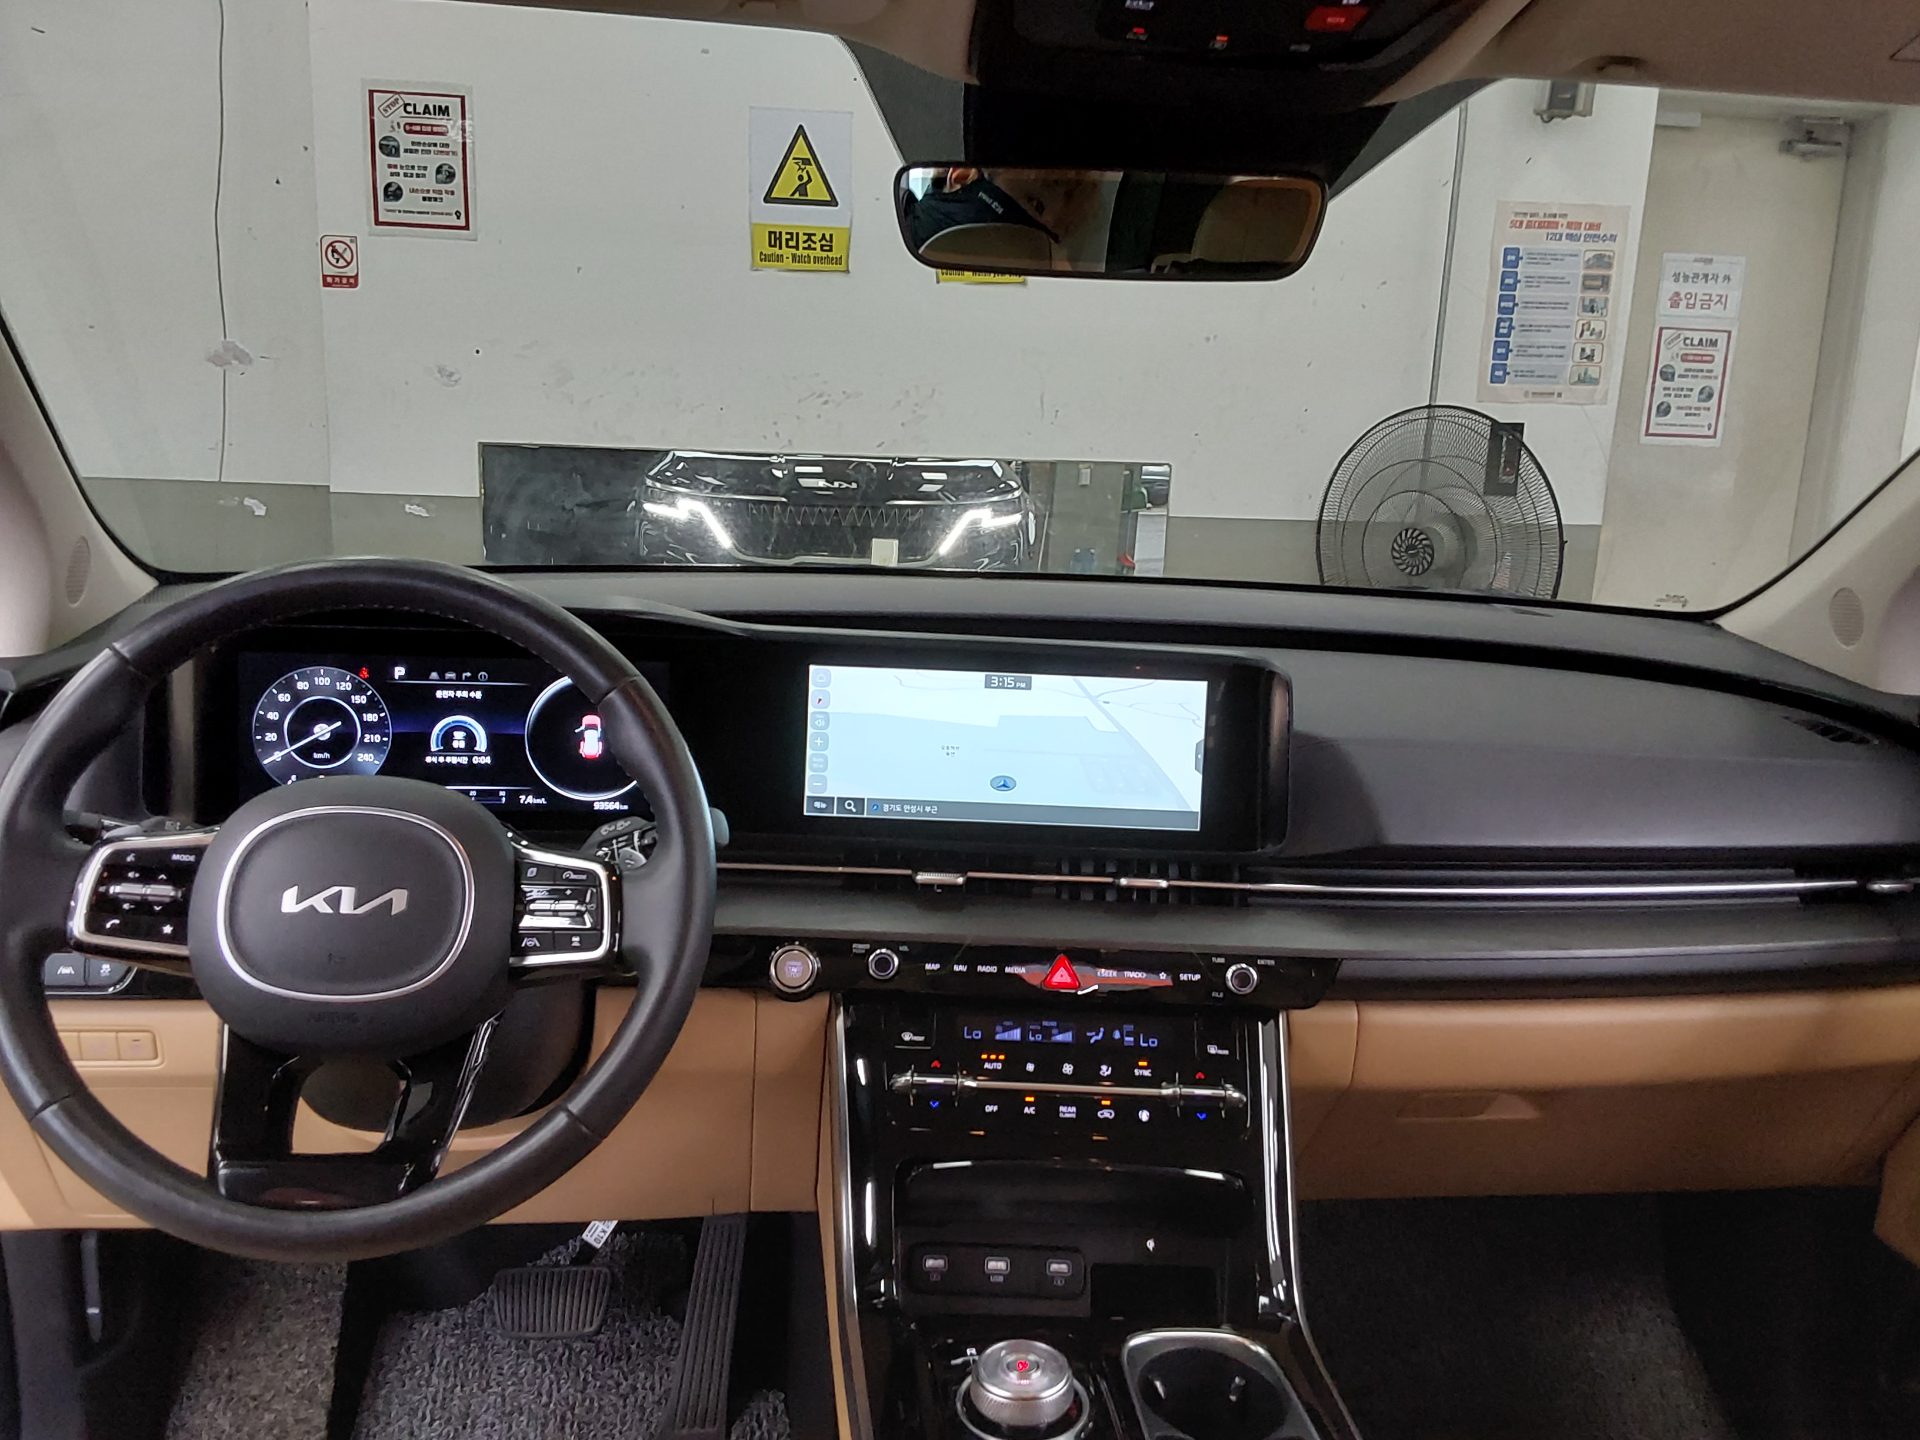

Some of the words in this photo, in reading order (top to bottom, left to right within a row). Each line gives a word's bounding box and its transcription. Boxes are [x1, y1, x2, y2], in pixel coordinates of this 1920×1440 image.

[382, 98, 400, 114] STOP
[403, 102, 450, 117] CLAIM
[768, 230, 834, 252] 머리조심
[759, 251, 784, 264] Caution
[791, 252, 811, 265] Watch
[812, 254, 843, 266] overhead
[1668, 291, 1729, 311] 출입금지
[1683, 337, 1718, 348] CLAIM
[394, 667, 406, 680] P
[297, 681, 310, 691] 80
[314, 677, 331, 686] 100
[336, 681, 352, 691] 120
[990, 676, 1015, 688] 3:15
[277, 693, 291, 703] 60
[350, 694, 367, 704] 150
[266, 711, 280, 721] 40
[362, 713, 378, 722] 180
[265, 733, 277, 742] 20
[364, 734, 380, 743] 210
[313, 752, 331, 760] km/h
[357, 753, 374, 762] 240
[472, 756, 491, 765] 0:04
[883, 804, 902, 813] 경기도
[172, 853, 196, 862] MODE
[925, 962, 940, 971] MAP
[953, 964, 968, 973] NAV
[977, 965, 998, 974] RADIO
[1004, 966, 1026, 974] MEDIA
[1179, 973, 1202, 982] SETUP
[984, 1062, 1003, 1070] AUTO
[1134, 1068, 1152, 1077] SYNC
[985, 1105, 998, 1113] OFF
[1023, 1106, 1036, 1115] A/C
[1059, 1105, 1077, 1113] REAR
